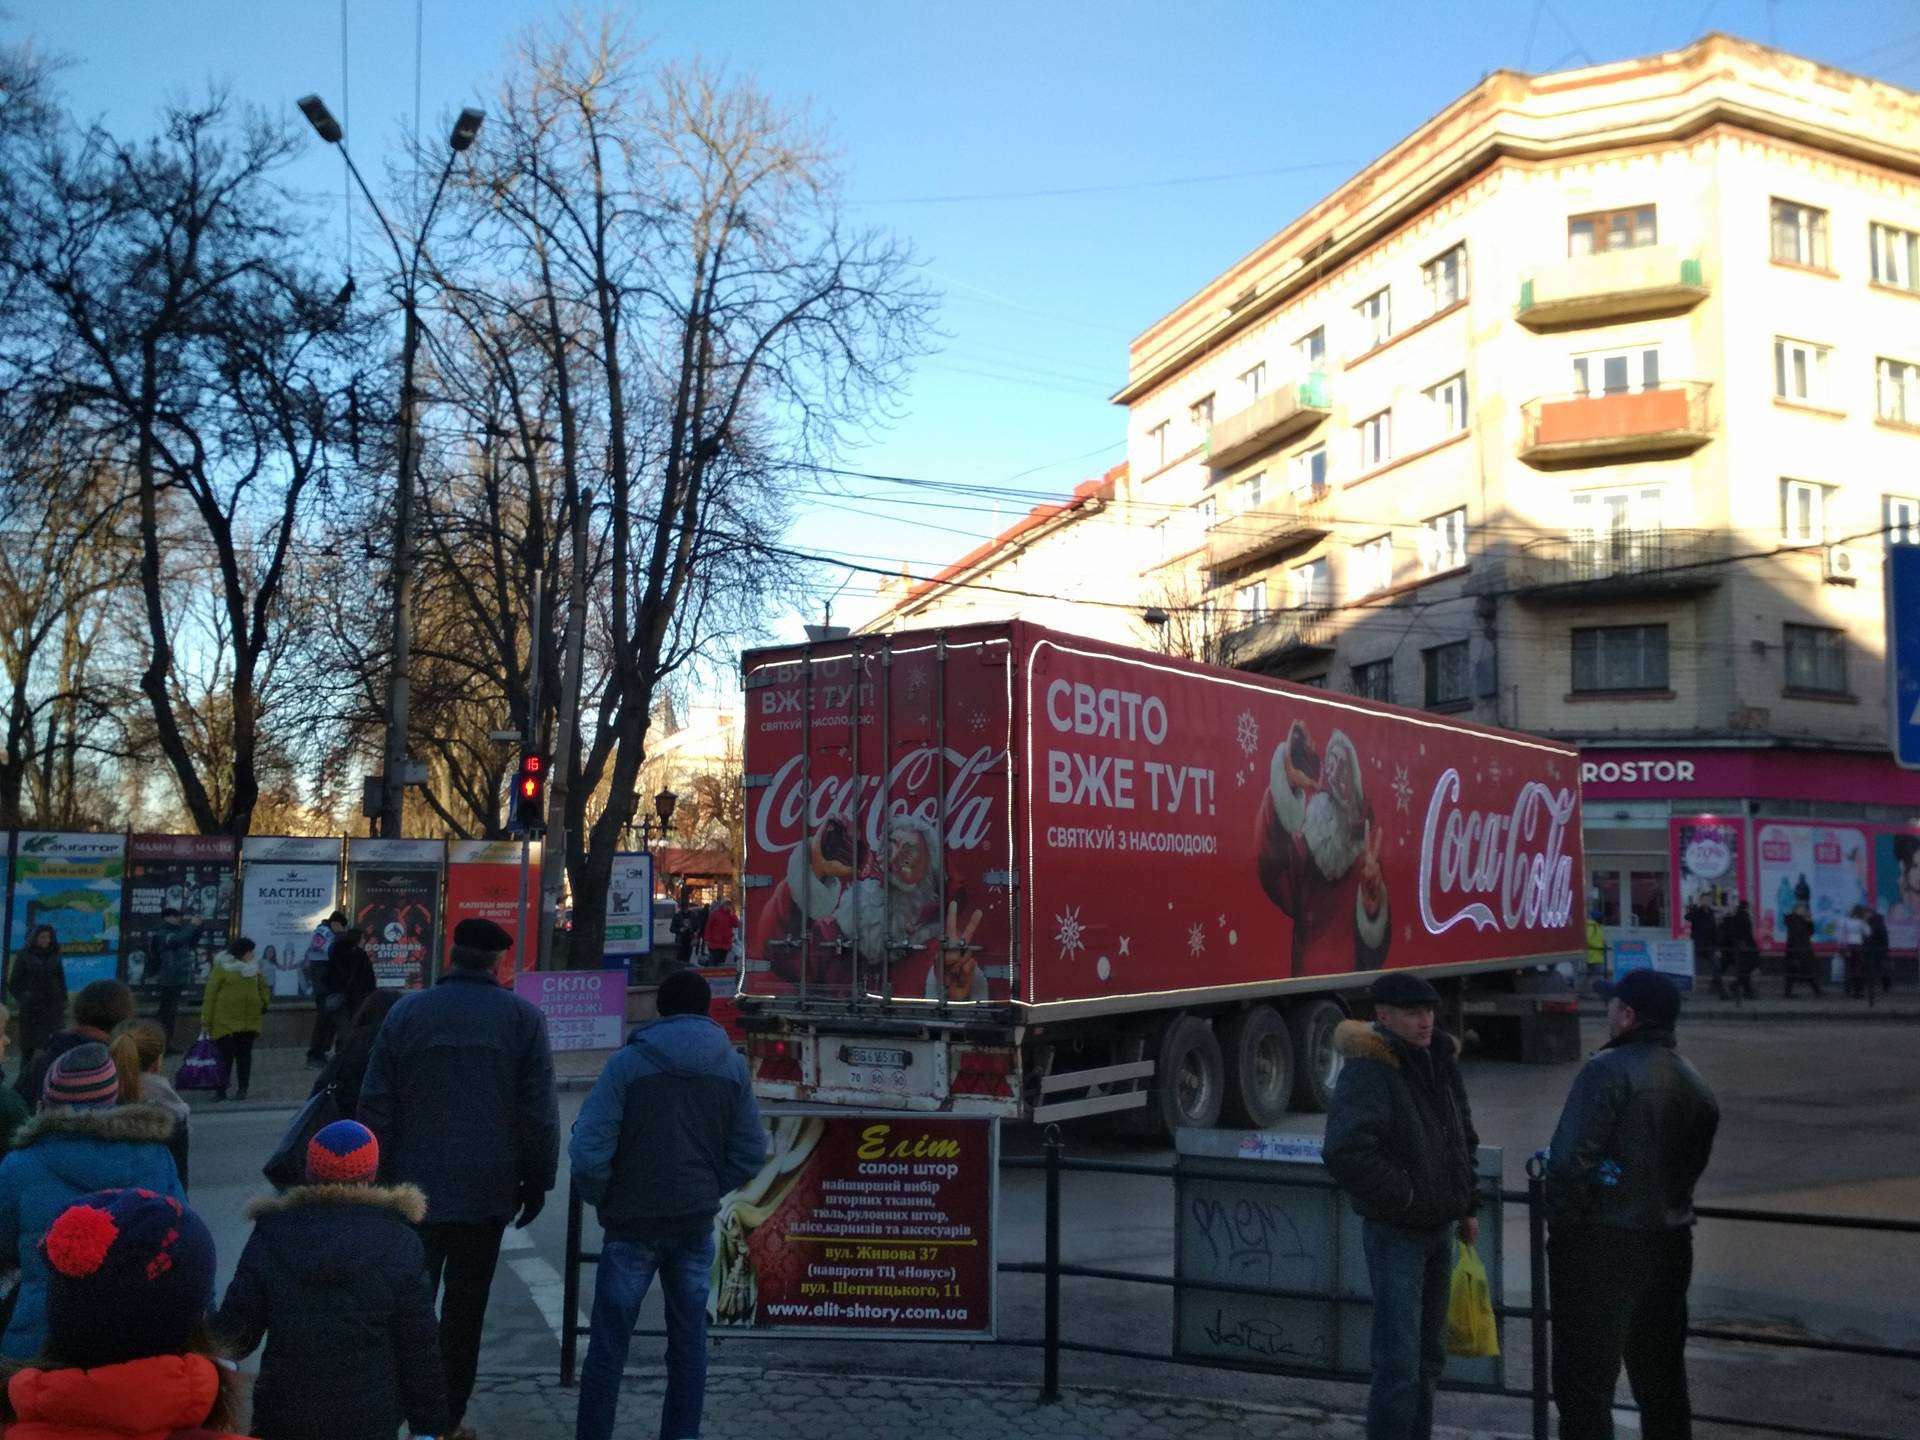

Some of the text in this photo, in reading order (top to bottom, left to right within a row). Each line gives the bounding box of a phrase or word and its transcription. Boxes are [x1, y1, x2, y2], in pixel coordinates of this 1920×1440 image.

[762, 683, 875, 715] ВЖЕ ТУТ!
[1047, 678, 1168, 746] СВЯТО
[760, 718, 802, 733] СВЯТКУЙ
[527, 757, 539, 771] 16
[1581, 759, 1696, 784] ROSTOR
[1049, 749, 1216, 816] ВЖЕ ТУТ!
[755, 746, 1009, 853] Coca-Cola
[1047, 824, 1217, 857] СВЯТКУЙ З НАСОЛОДОЮ!
[1418, 767, 1577, 935] Coca-Cola
[258, 887, 326, 898] КАСТИНГ
[543, 975, 602, 992] СКЛО
[850, 1071, 862, 1083] 70
[857, 1123, 961, 1161] Еліт
[857, 1163, 959, 1180] салон штор
[822, 1178, 940, 1195] найширший вибір
[825, 1194, 882, 1208] шторних
[884, 1226, 900, 1235] та
[902, 1223, 972, 1239] аксесуарів
[825, 1245, 939, 1262] вул. Живова 37
[807, 1262, 875, 1281] (навпроти
[877, 1264, 897, 1281] ТЦ
[800, 1283, 830, 1297] вул.
[944, 1283, 961, 1297] 11
[767, 1301, 968, 1322] www.elit-shtory.com.ua
